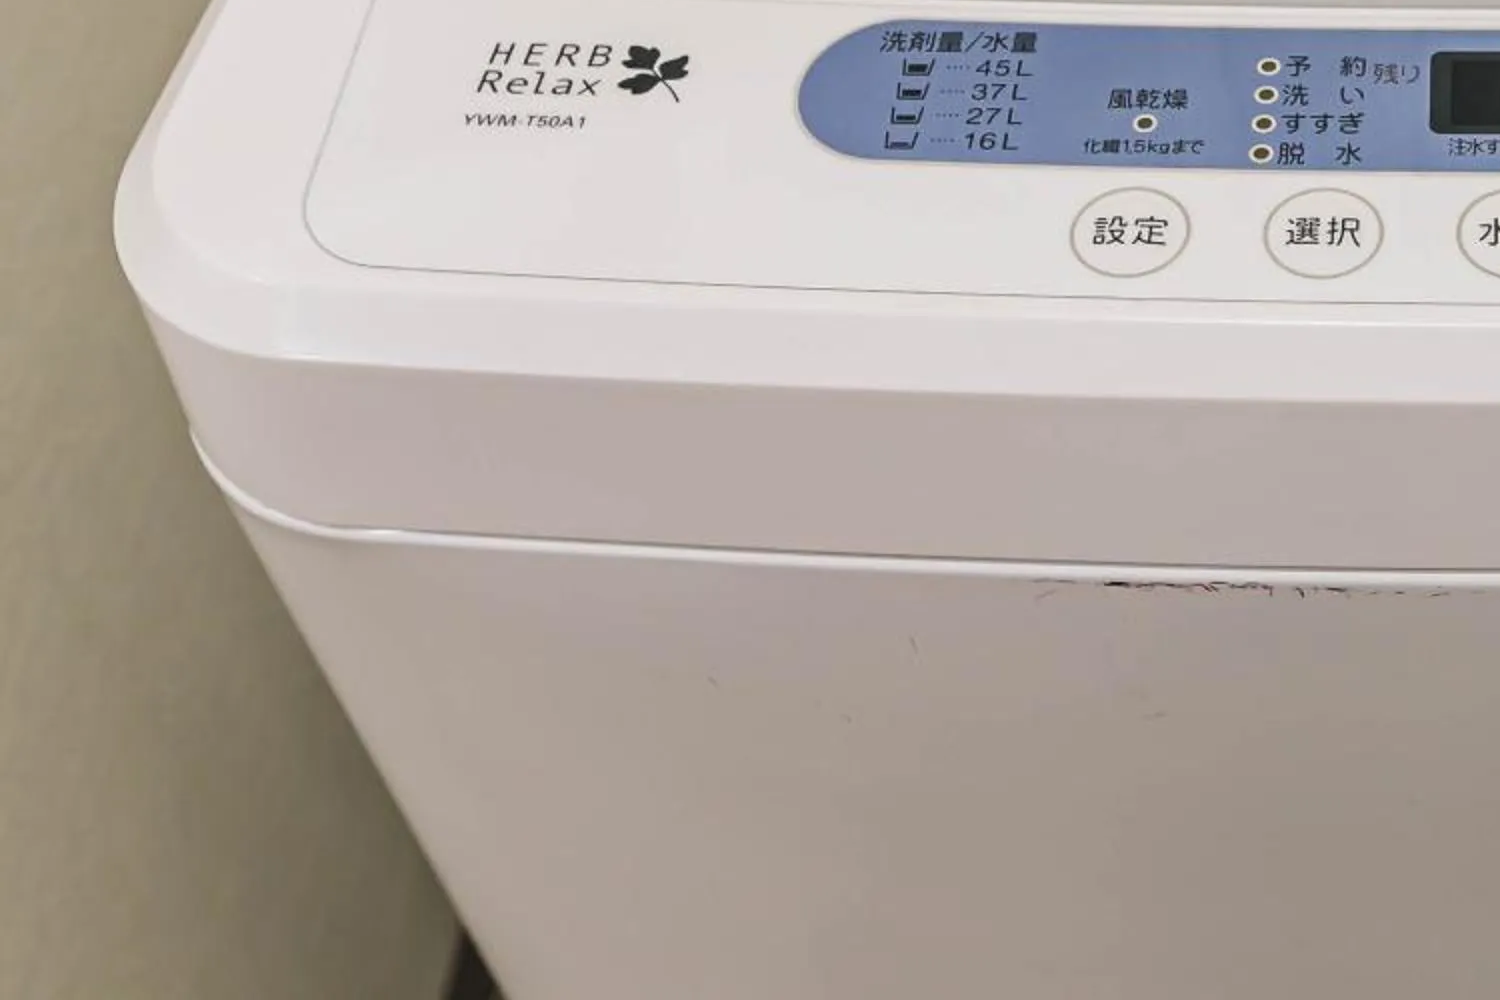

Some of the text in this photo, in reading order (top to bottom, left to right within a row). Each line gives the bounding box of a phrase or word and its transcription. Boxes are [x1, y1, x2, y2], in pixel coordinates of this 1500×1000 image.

[490, 43, 612, 67] HERB
[477, 69, 601, 95] Relax
[1374, 64, 1420, 84] 残り
[1108, 89, 1188, 110] 風乾燥
[1281, 113, 1364, 134] すすぎ
[1093, 216, 1168, 245] 設定
[1286, 217, 1360, 247] 選択
